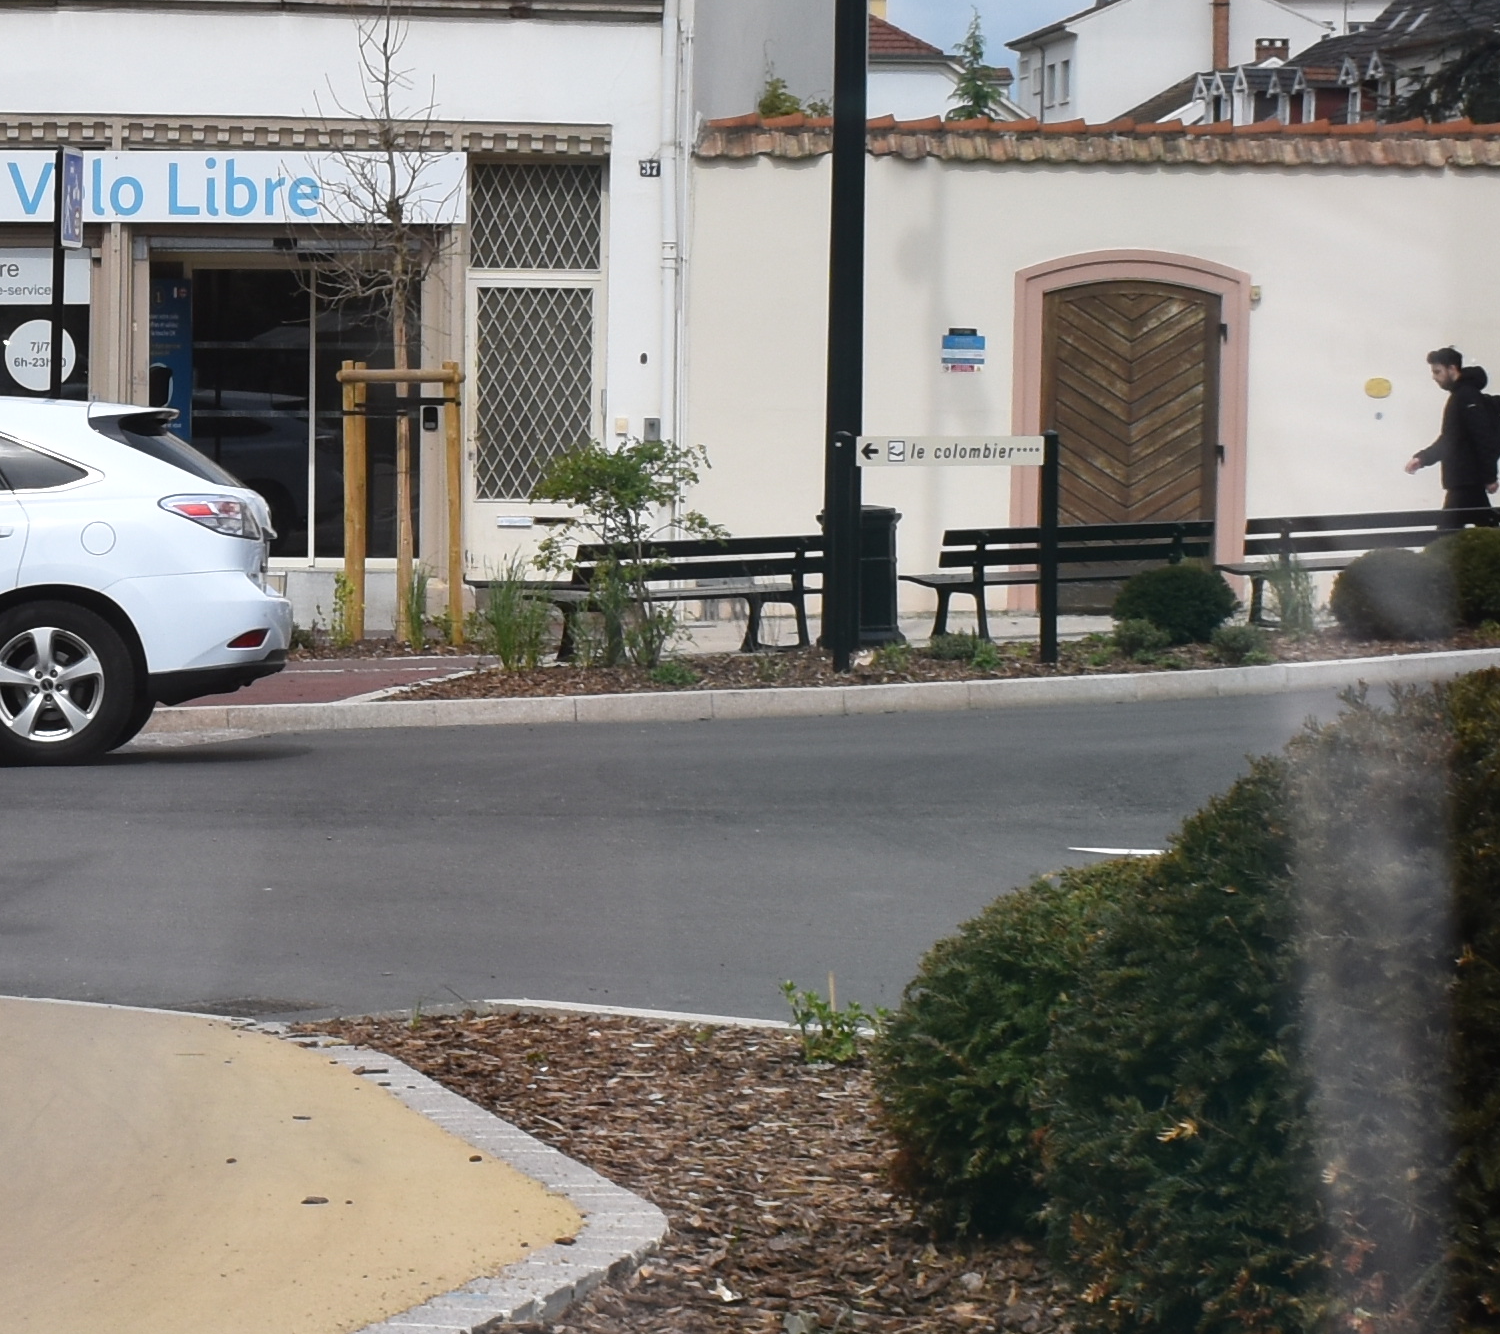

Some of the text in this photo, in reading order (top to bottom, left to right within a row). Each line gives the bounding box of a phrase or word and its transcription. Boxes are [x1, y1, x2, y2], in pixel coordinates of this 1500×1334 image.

[641, 162, 659, 176] 37
[7, 157, 144, 217] Vlo
[168, 157, 321, 217] Libre
[910, 443, 1014, 459] le colombier
